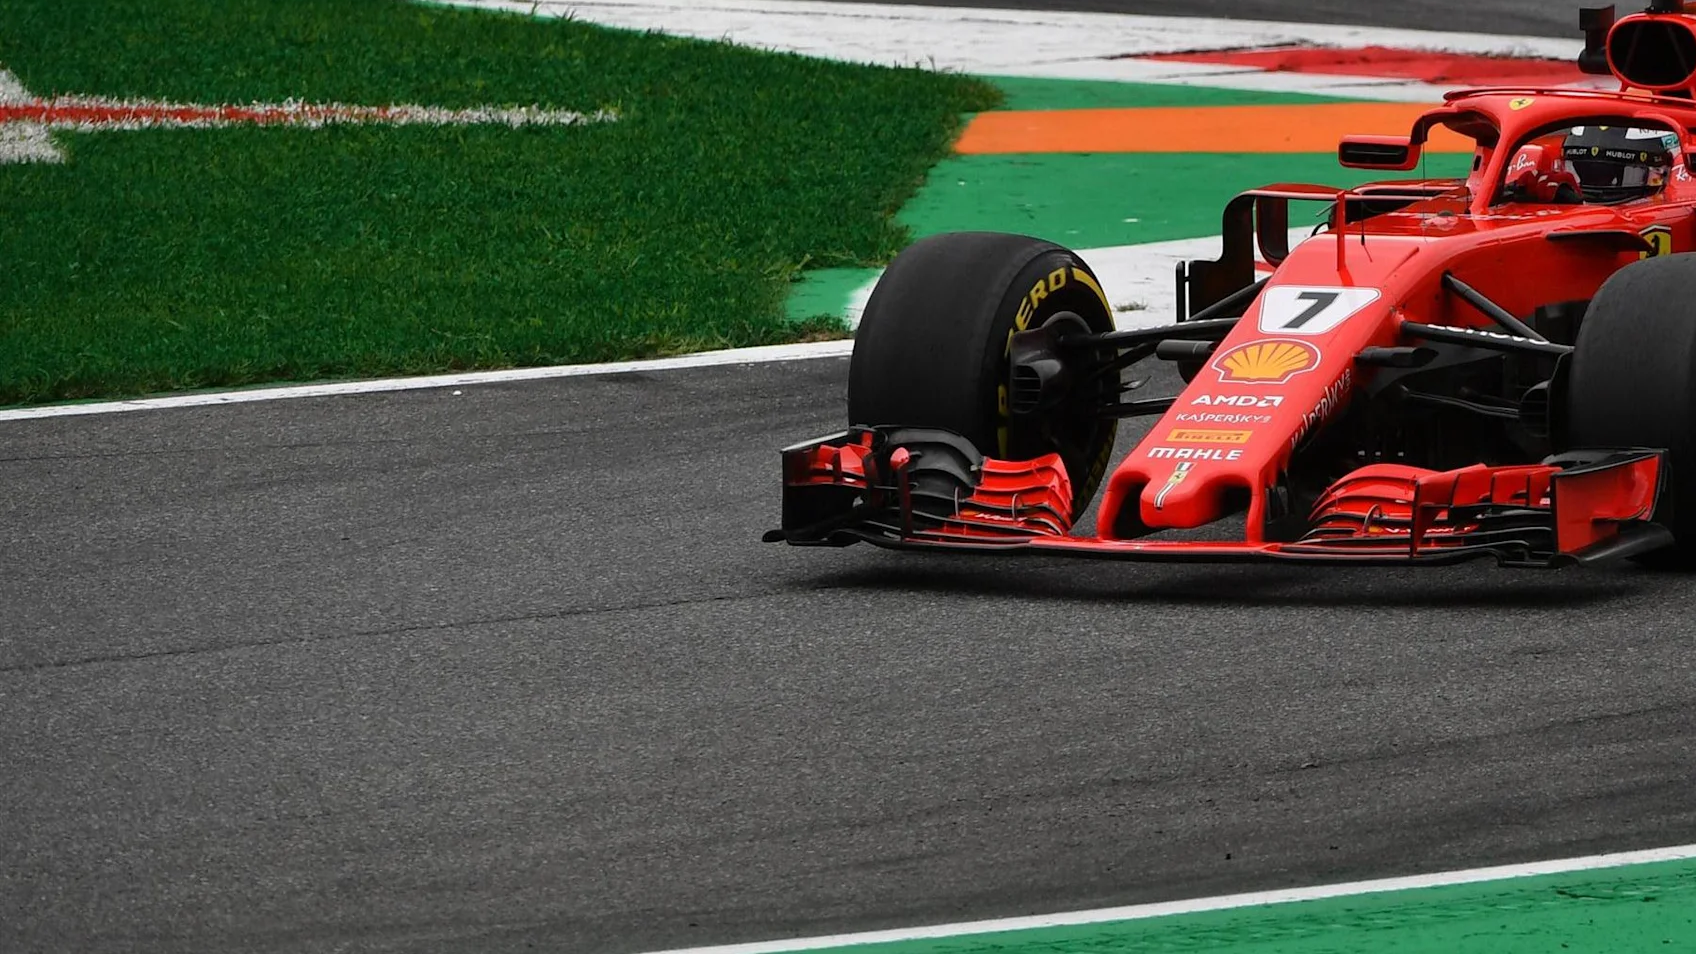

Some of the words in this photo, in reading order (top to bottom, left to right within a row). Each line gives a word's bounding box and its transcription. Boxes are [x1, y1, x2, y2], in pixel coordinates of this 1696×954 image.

[1605, 150, 1636, 160] HUBLOT
[1281, 291, 1342, 330] 7
[1191, 395, 1259, 407] AMD
[1175, 412, 1262, 424] KASPERSKY
[1147, 447, 1244, 461] MAHLE
